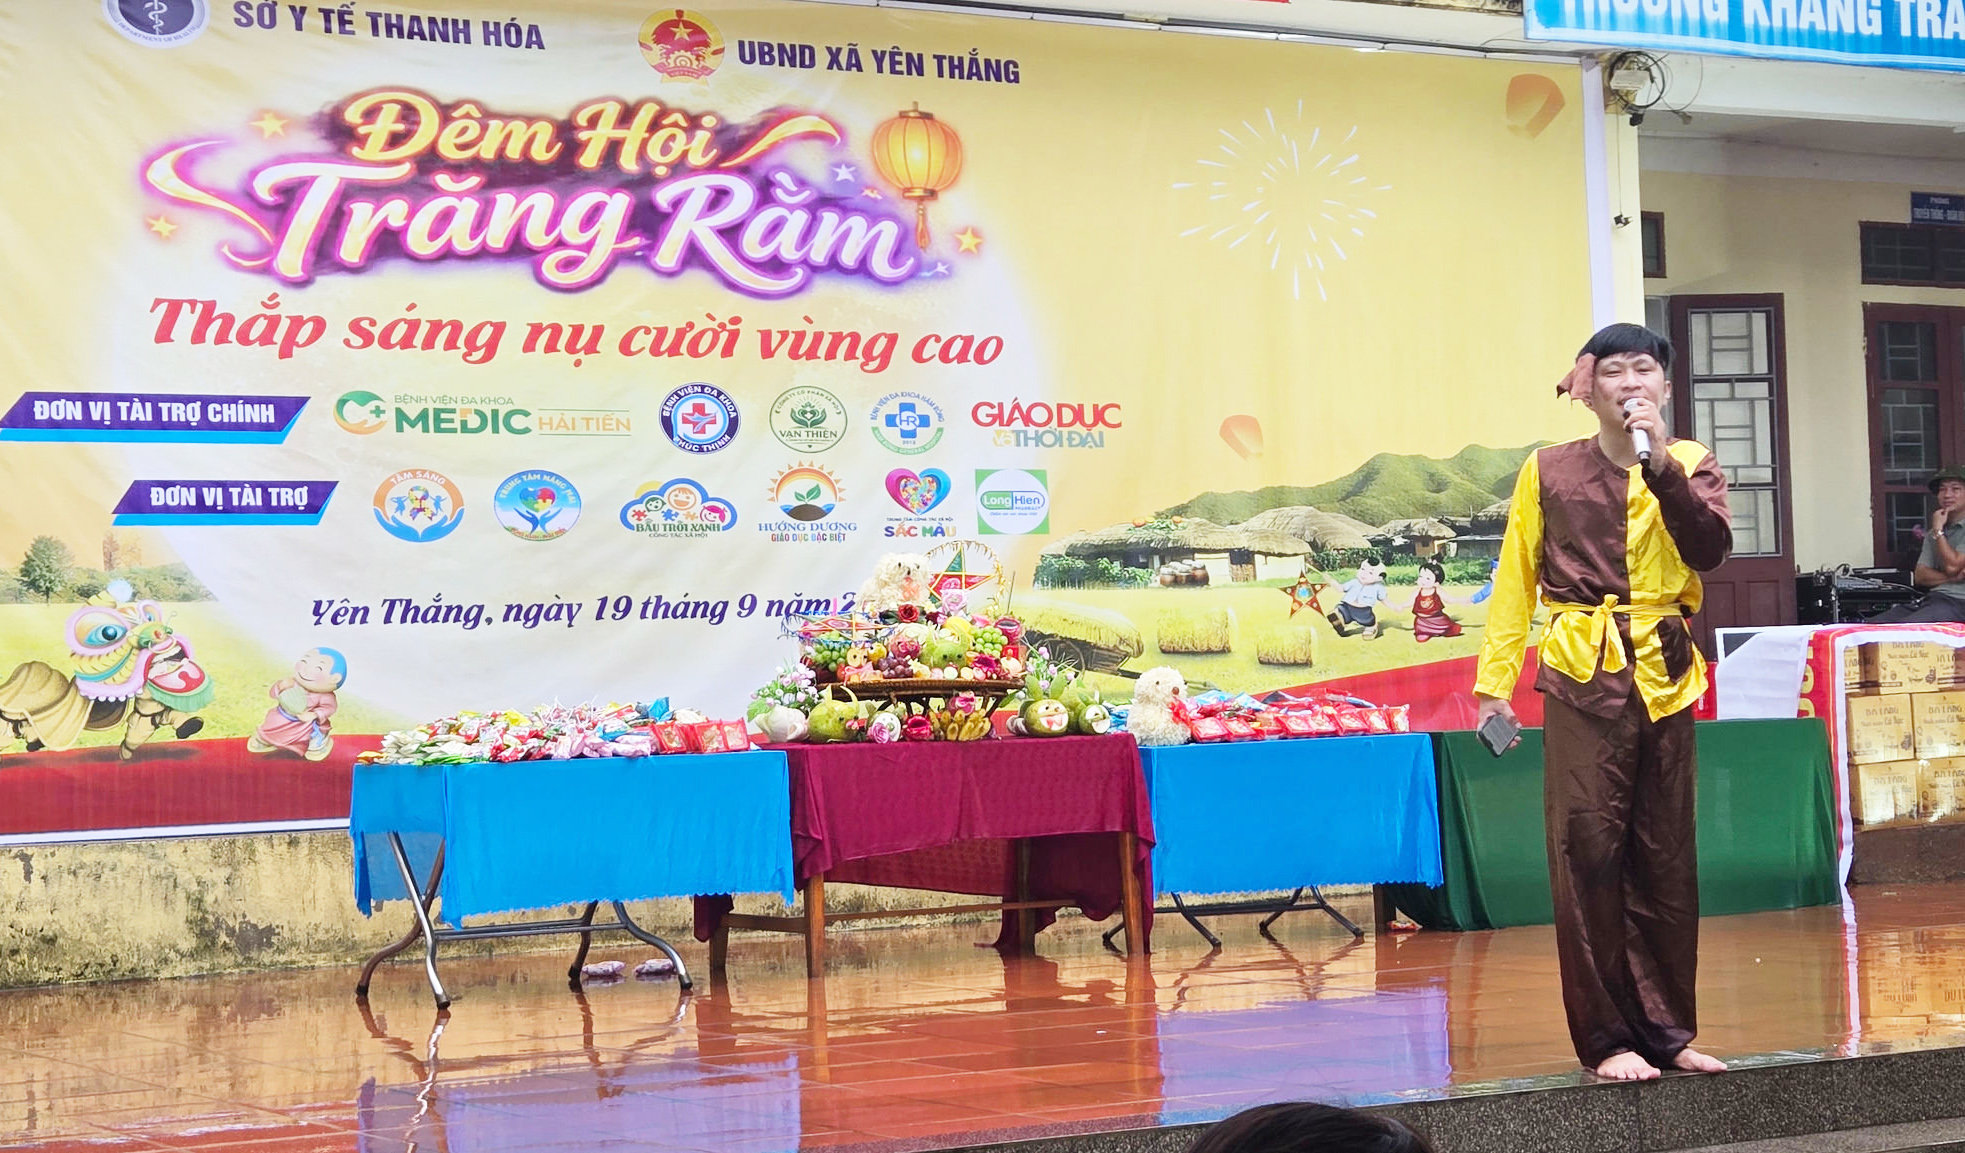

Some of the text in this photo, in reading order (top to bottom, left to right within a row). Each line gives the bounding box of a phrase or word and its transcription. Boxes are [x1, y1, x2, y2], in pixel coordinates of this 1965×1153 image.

[233, 0, 546, 50] SỞ Y TẾ THANH HÓA
[737, 39, 1020, 84] UBND XÃ YÊN THẮNG
[344, 91, 718, 176] Đêm Hội
[252, 161, 914, 291] Trăng Rằm
[151, 292, 1004, 374] Thắp sáng nụ cười vùng cao
[34, 397, 275, 426] ĐƠN VỊ TÀI TRỢ CHÍNH
[394, 393, 515, 406] BỆNH VIỆN ĐA KHOA
[719, 394, 737, 418] KHOA
[395, 407, 533, 435] MEDIC
[538, 412, 632, 432] HẢI TIẾN
[971, 396, 1123, 432] GIÁO DỤC
[1066, 430, 1105, 449] ĐẠI
[150, 483, 309, 510] ĐƠN VỊ TÀI TRỢ
[983, 495, 1011, 508] Long
[690, 523, 721, 532] XANH
[758, 520, 857, 532] HƯỚNG DƯƠNG
[884, 520, 957, 537] SẮC MÀU
[312, 598, 370, 626] Yên
[381, 592, 493, 630] Thắng,
[502, 594, 583, 629] ngày
[595, 595, 633, 621] 19
[639, 592, 729, 626] tháng
[736, 593, 758, 618] 9
[764, 592, 831, 617] năm
